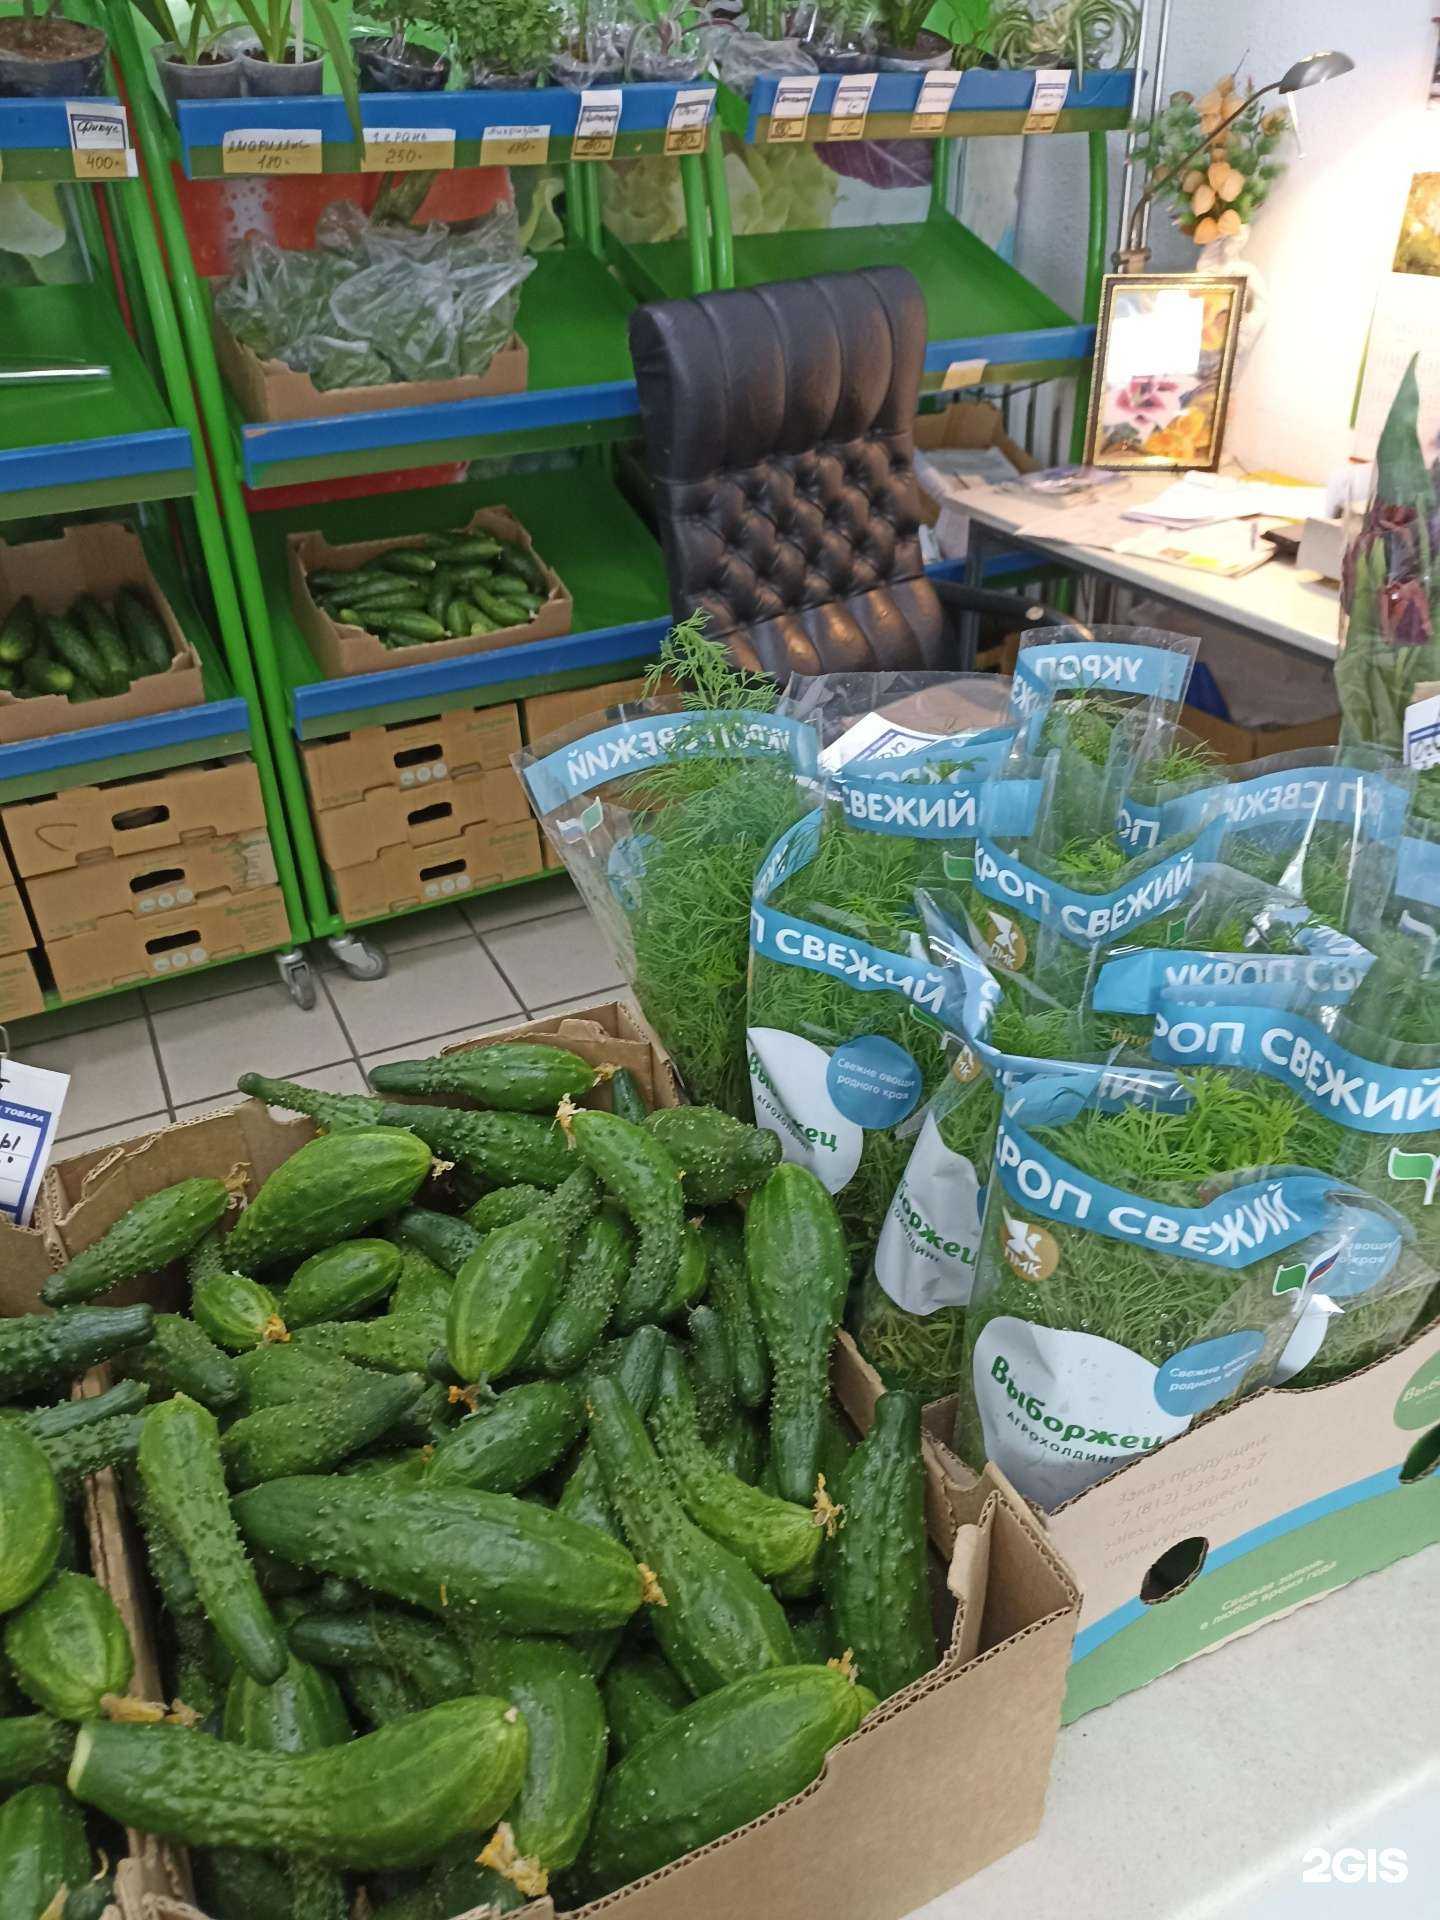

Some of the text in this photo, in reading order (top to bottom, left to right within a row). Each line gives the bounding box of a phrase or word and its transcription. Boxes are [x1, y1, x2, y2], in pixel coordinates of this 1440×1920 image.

[975, 840, 1194, 938] РОП СВЕЖИЙ
[775, 928, 947, 1014] СВЕЖИЙ
[836, 1075, 880, 1094] родного
[837, 1058, 878, 1078] Свежие
[1153, 1012, 1440, 1121] РОП СВЕЖИЙ
[4, 1106, 45, 1124] ТОВАРА
[996, 1125, 1302, 1256] РОП СВЕЖИЙ
[991, 1355, 1163, 1451] Выборжец
[1007, 1411, 1118, 1465] АГРОХОЛДИНГ
